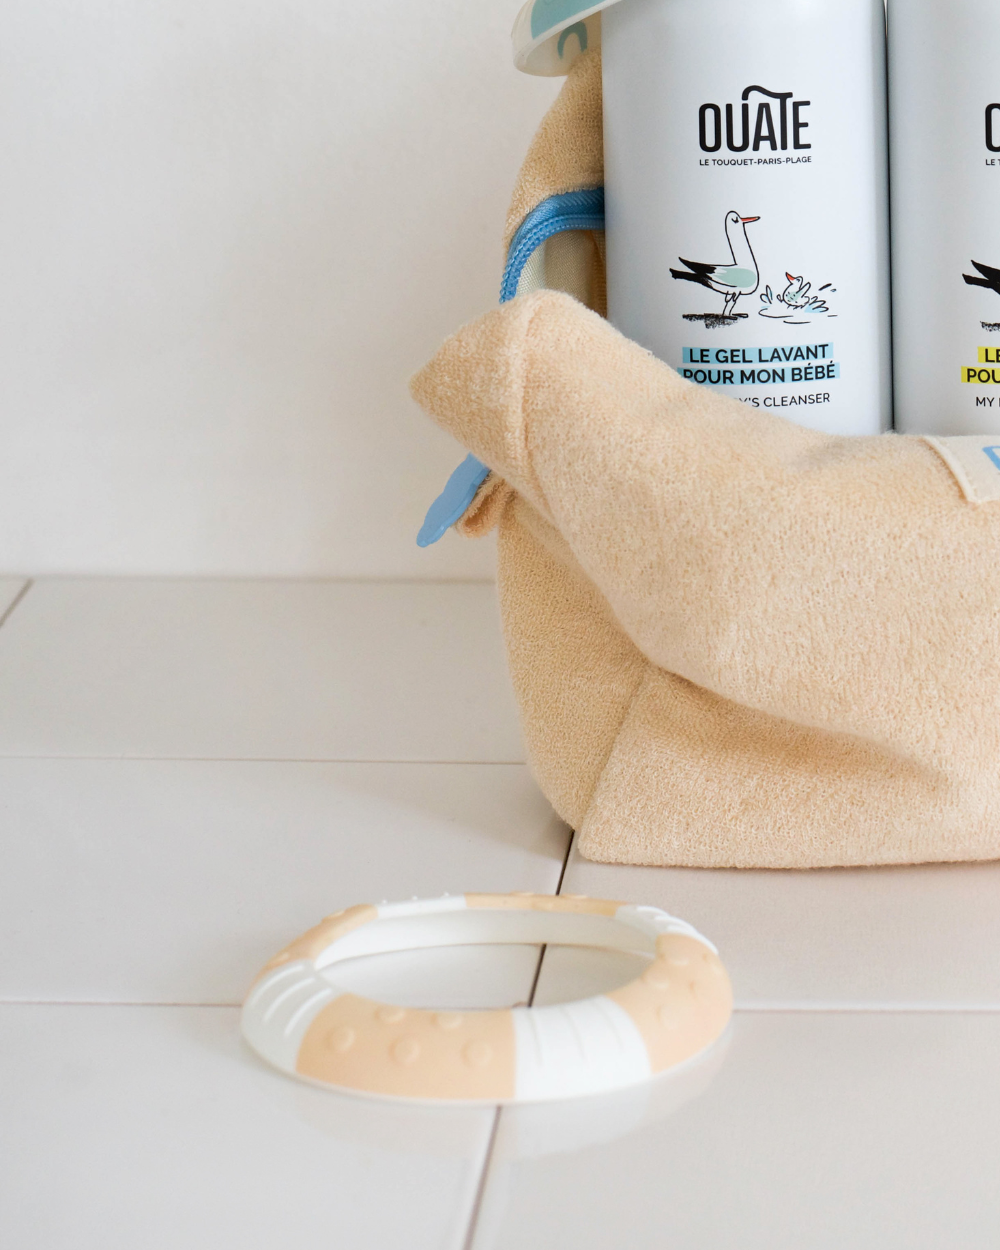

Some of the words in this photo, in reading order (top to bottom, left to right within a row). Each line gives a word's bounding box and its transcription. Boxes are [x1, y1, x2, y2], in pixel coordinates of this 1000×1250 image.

[699, 85, 811, 152] OUATE
[712, 156, 812, 166] TOUQUET-PARIS-PLAGE
[689, 348, 710, 363] LE
[715, 349, 753, 363] GEL
[758, 344, 829, 362] LAVANT
[683, 369, 734, 384] POUR
[740, 368, 785, 384] MON
[791, 360, 836, 382] BÉBÉ
[763, 393, 830, 407] CLEANSER
[976, 397, 995, 407] MY
